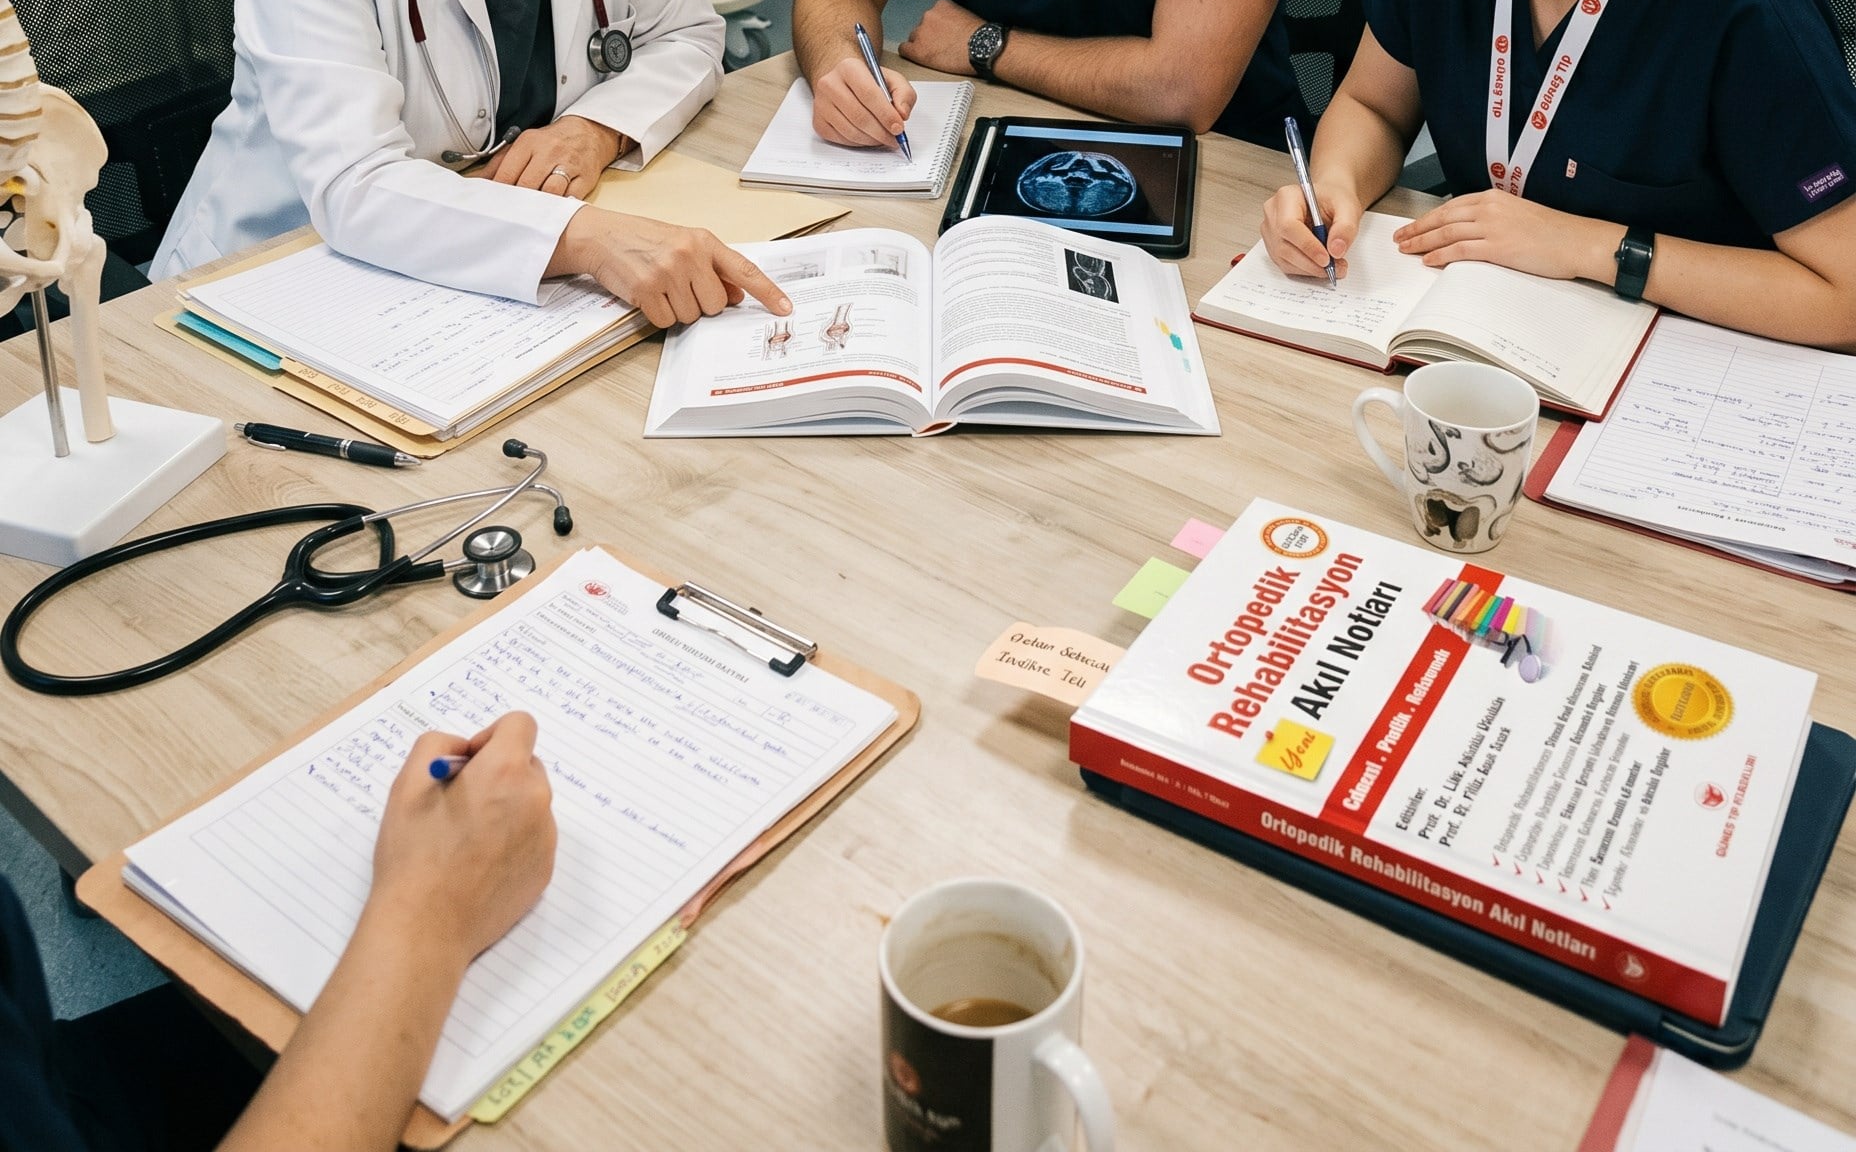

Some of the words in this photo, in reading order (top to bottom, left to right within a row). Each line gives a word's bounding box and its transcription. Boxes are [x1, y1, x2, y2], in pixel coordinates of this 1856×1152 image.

[1556, 54, 1573, 74] TIP
[1186, 565, 1301, 686] Ortopedik
[1207, 552, 1364, 739] Rehabilitasyon
[1290, 660, 1351, 721] Akıl
[1326, 581, 1402, 661] Notları
[1260, 812, 1345, 859] Ortopedik
[1350, 845, 1484, 915] Rehabilitasyon
[1489, 905, 1526, 933] Akıl
[1531, 919, 1597, 961] Notları
